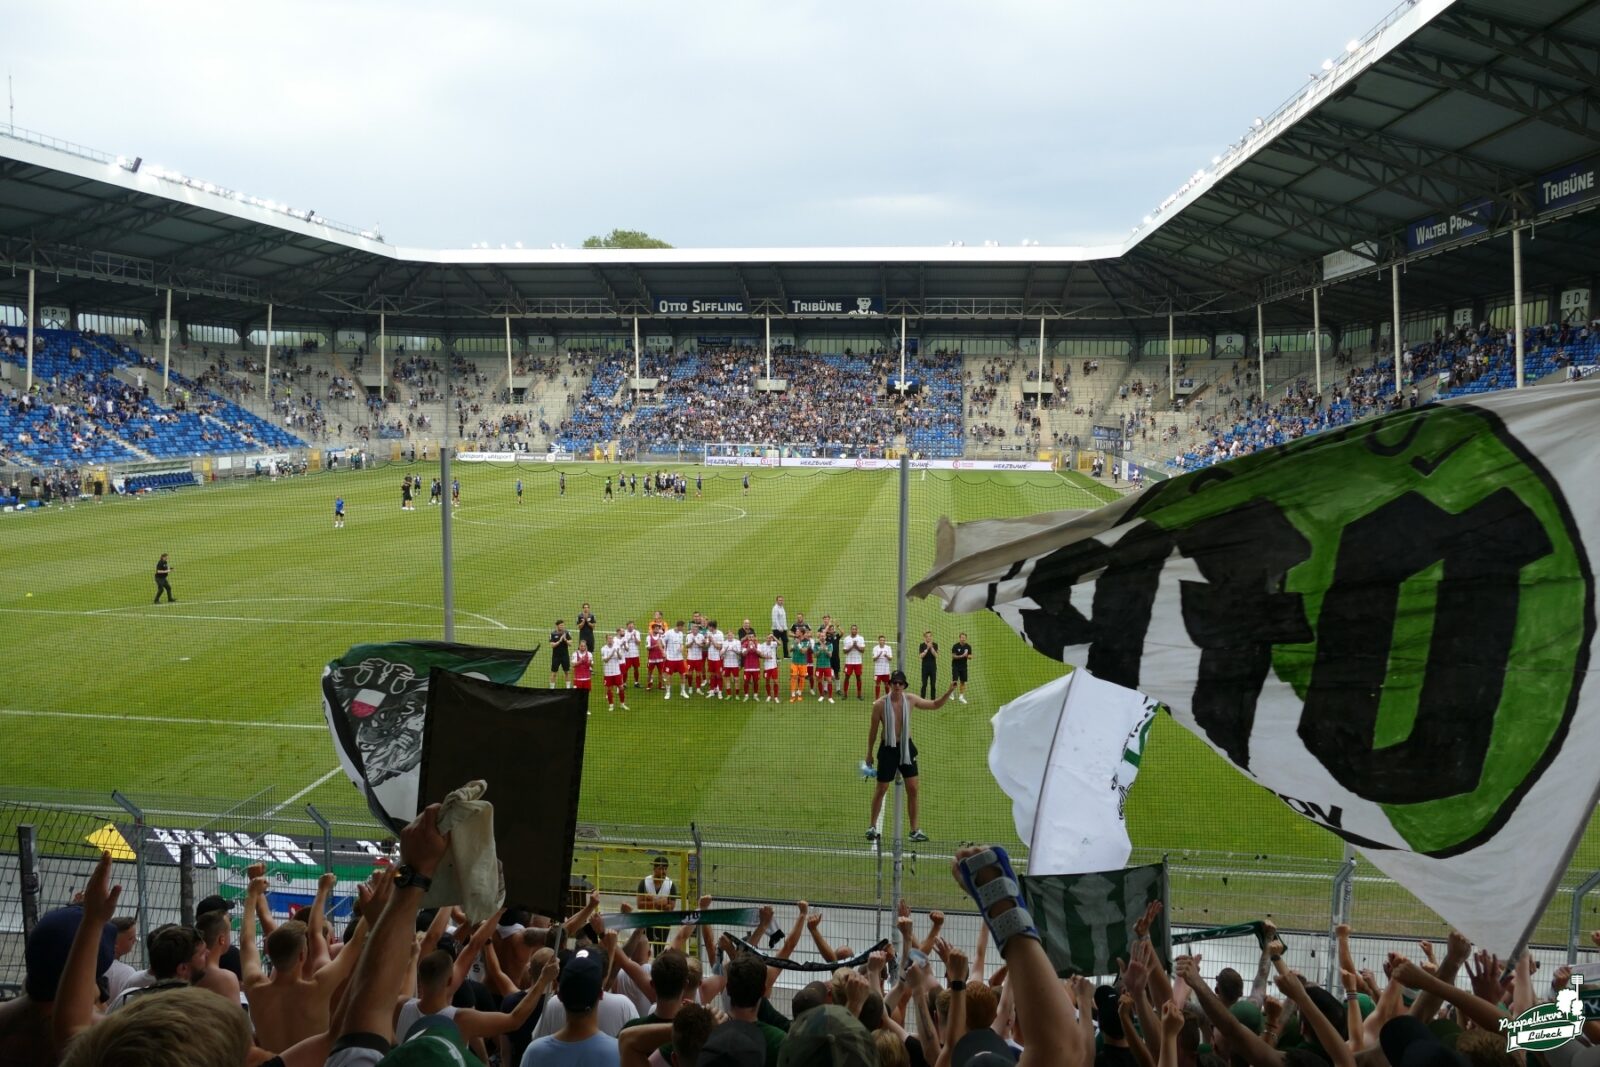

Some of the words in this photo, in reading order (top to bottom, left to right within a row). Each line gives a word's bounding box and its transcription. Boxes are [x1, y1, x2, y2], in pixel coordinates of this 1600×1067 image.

[1543, 172, 1595, 204] TRIBÜNE
[1416, 226, 1447, 245] WALTER
[1574, 292, 1580, 305] D
[51, 308, 57, 317] P
[659, 300, 687, 313] OTTO
[692, 300, 743, 313] SIFFLING
[792, 300, 842, 313] TRIBÜNE
